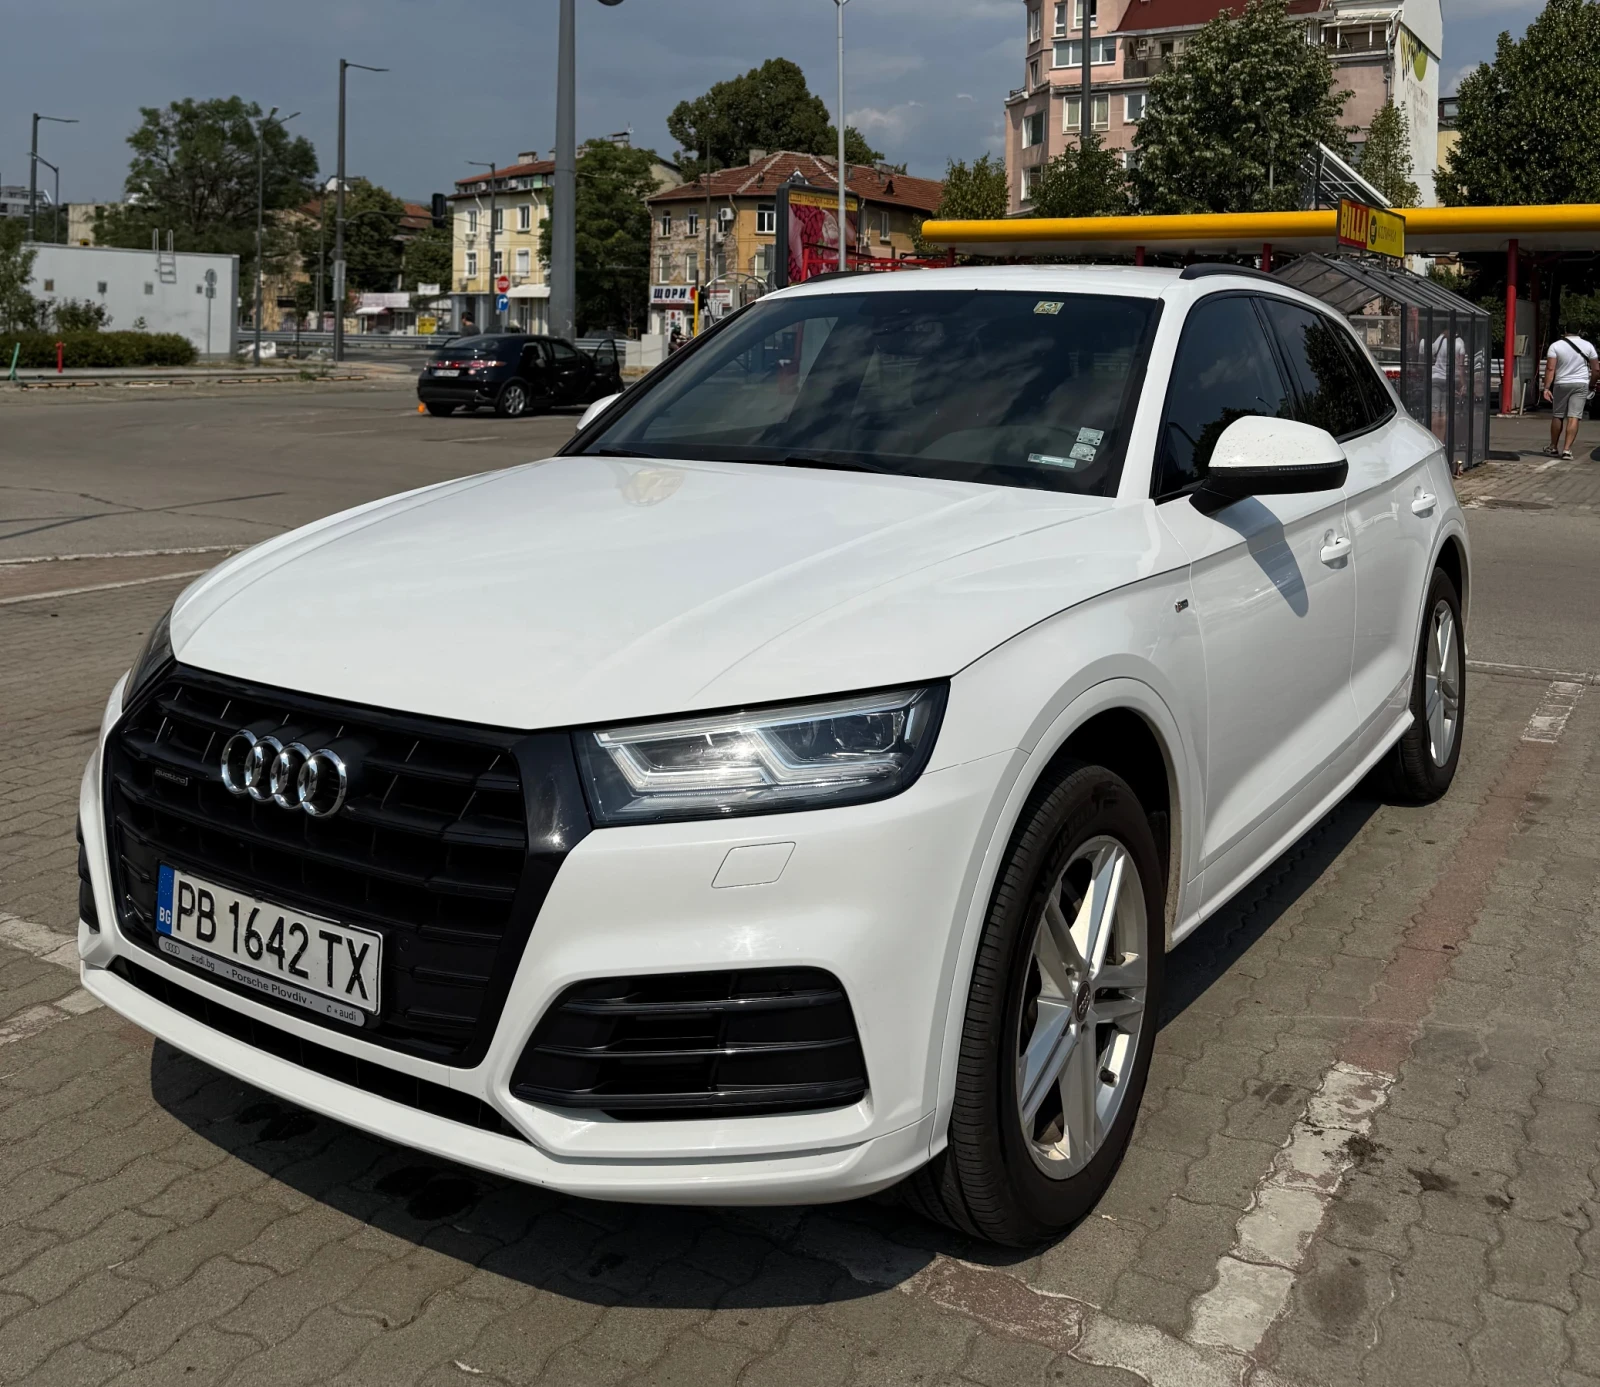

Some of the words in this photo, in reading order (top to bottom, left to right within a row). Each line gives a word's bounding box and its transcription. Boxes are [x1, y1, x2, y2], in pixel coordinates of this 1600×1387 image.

[1340, 203, 1366, 243] BILLA
[653, 288, 687, 299] ЩОРИ
[155, 769, 186, 784] quattro
[158, 906, 172, 925] BG
[176, 879, 217, 943] PB
[228, 900, 309, 980] 1642
[319, 929, 370, 1001] TX
[191, 953, 216, 972] audi.bg
[231, 968, 270, 991] Porsche
[271, 984, 308, 1005] Plovdiv
